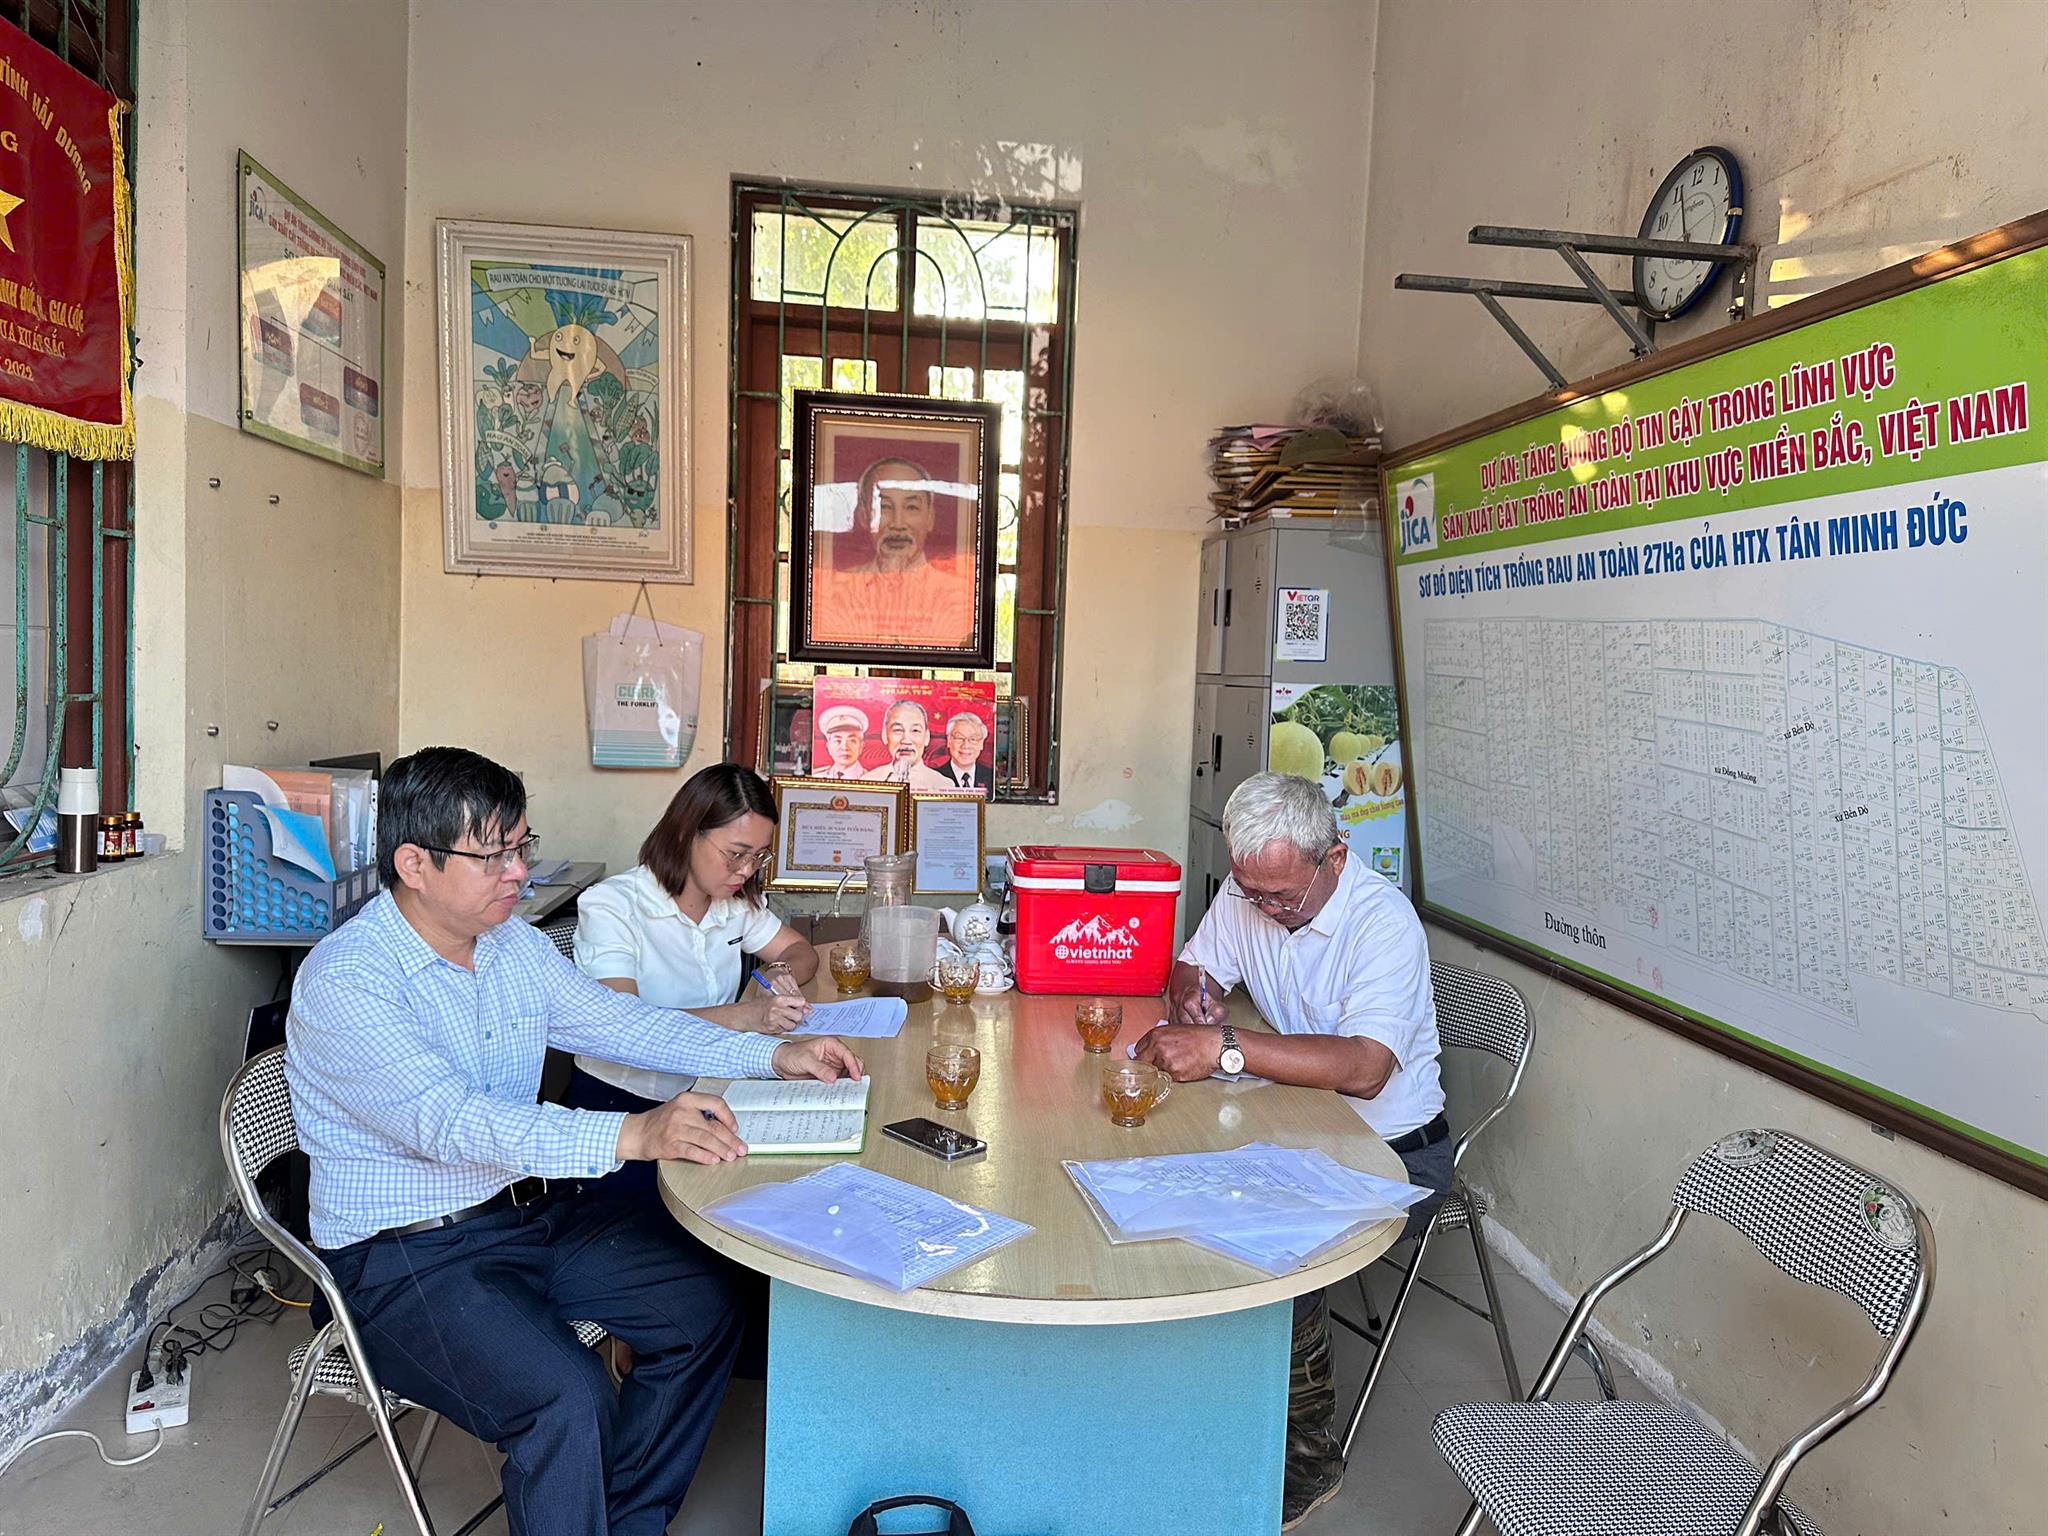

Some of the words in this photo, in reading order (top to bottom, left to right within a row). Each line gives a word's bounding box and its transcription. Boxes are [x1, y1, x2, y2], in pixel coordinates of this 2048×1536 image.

[32, 92, 54, 130] HẢI
[1691, 165, 1705, 187] 12
[1713, 166, 1720, 186] 1
[1673, 184, 1684, 205] 11
[1657, 212, 1669, 232] 10
[1649, 270, 1657, 289] 8
[1660, 287, 1668, 305] 7
[1481, 462, 1498, 493] DỰ
[1499, 451, 1520, 484] ÁN:
[1522, 444, 1556, 480] TĂNG
[1611, 415, 1632, 463] ĐỘ
[1636, 410, 1664, 450] TIN
[1669, 396, 1703, 446] CẬY
[1708, 380, 1774, 431] TRONG
[1781, 361, 1835, 412] LĨNH
[1841, 344, 1895, 402] VỰC
[1442, 502, 1464, 540] SẢN
[1466, 496, 1494, 535] XUẤT
[1496, 494, 1519, 531] CÂY
[1522, 482, 1564, 525] TRỒNG
[1569, 485, 1588, 516] AN
[1591, 470, 1632, 512] TOÀN
[1635, 466, 1660, 510] TẠI
[1664, 456, 1701, 498] KHU
[1706, 447, 1743, 493] VỰC
[1749, 423, 1806, 482] MIỀN
[1813, 412, 1872, 469] BẮC,
[1878, 398, 1940, 461] VIỆT
[1949, 383, 2029, 443] NAM
[1419, 571, 1432, 598] SƠ
[1434, 564, 1447, 596] ĐỒ
[1449, 566, 1473, 599] DIỆN
[1475, 560, 1501, 591] TÍCH
[1503, 552, 1544, 588] TRỒNG
[1546, 554, 1573, 584] RAU
[1577, 551, 1597, 580] AN
[1599, 542, 1639, 579] TOÀN
[1643, 543, 1685, 575] 27Ha
[1690, 521, 1727, 570] CỦA
[1732, 528, 1771, 566] HTX
[1776, 516, 1821, 561] TÂN
[1828, 510, 1899, 556] MINH
[1907, 491, 1968, 548] ĐỨC
[1544, 912, 1580, 944] Đường
[1582, 925, 1607, 949] thôn
[1069, 945, 1132, 959] vietnhat
